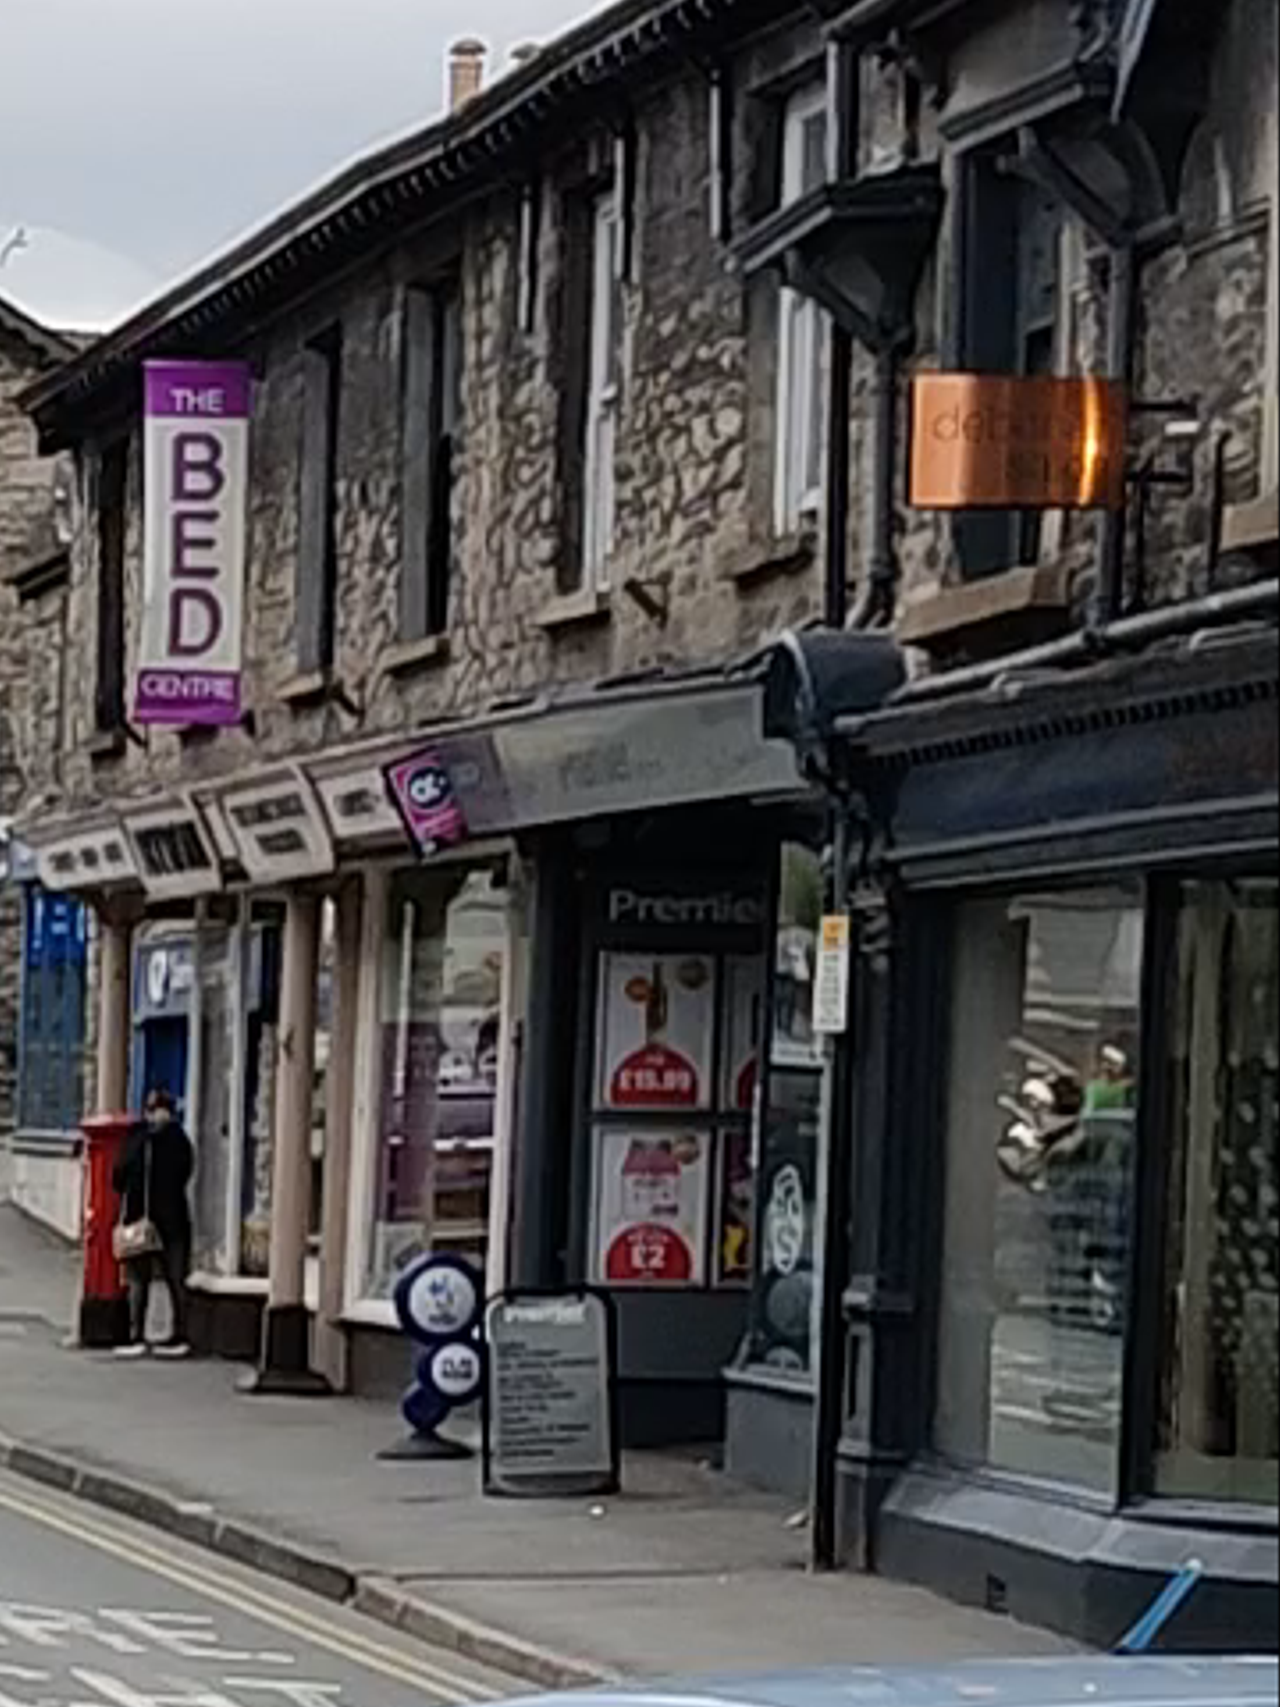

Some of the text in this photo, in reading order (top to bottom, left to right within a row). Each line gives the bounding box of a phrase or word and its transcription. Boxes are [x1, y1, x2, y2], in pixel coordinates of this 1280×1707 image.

[169, 387, 225, 413] THE
[167, 431, 226, 658] BED
[141, 674, 236, 700] CENTRE
